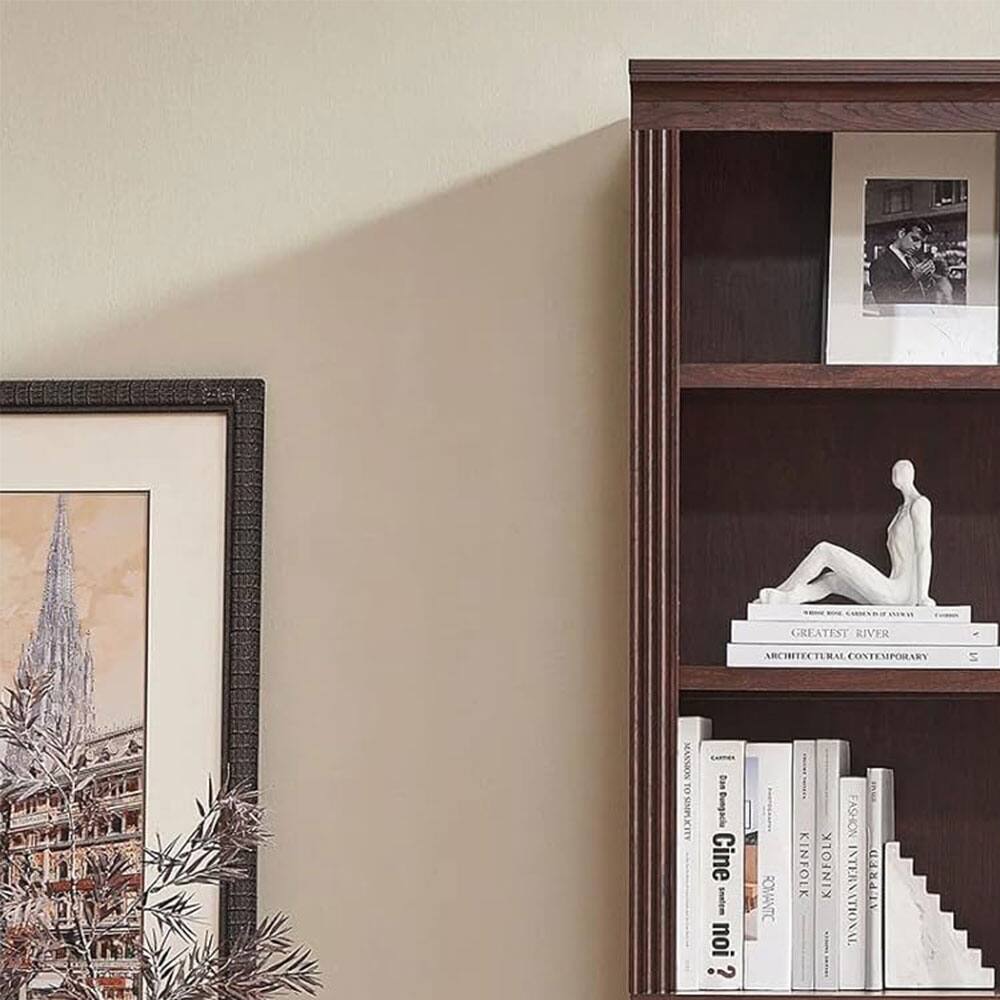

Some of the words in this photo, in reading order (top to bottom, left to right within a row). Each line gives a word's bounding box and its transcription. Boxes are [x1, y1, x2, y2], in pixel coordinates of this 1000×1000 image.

[791, 628, 849, 638] GREATEST
[856, 628, 890, 639] RIVER
[764, 652, 845, 660] ARCHITECTURAL
[847, 652, 928, 661] CONTEMPORARY
[684, 783, 691, 795] TO
[719, 775, 728, 790] Dan
[683, 797, 691, 841] SIMPLICITY
[717, 792, 728, 828] Dungaciu
[848, 795, 858, 838] FASHION
[712, 833, 736, 882] Cine
[799, 832, 809, 899] KINFOLK
[821, 832, 832, 899] KINFOLK
[761, 875, 775, 922] ROMANTIC
[847, 845, 858, 946] INTERNATIONAL
[711, 923, 736, 957] noi
[707, 965, 736, 979] ?
